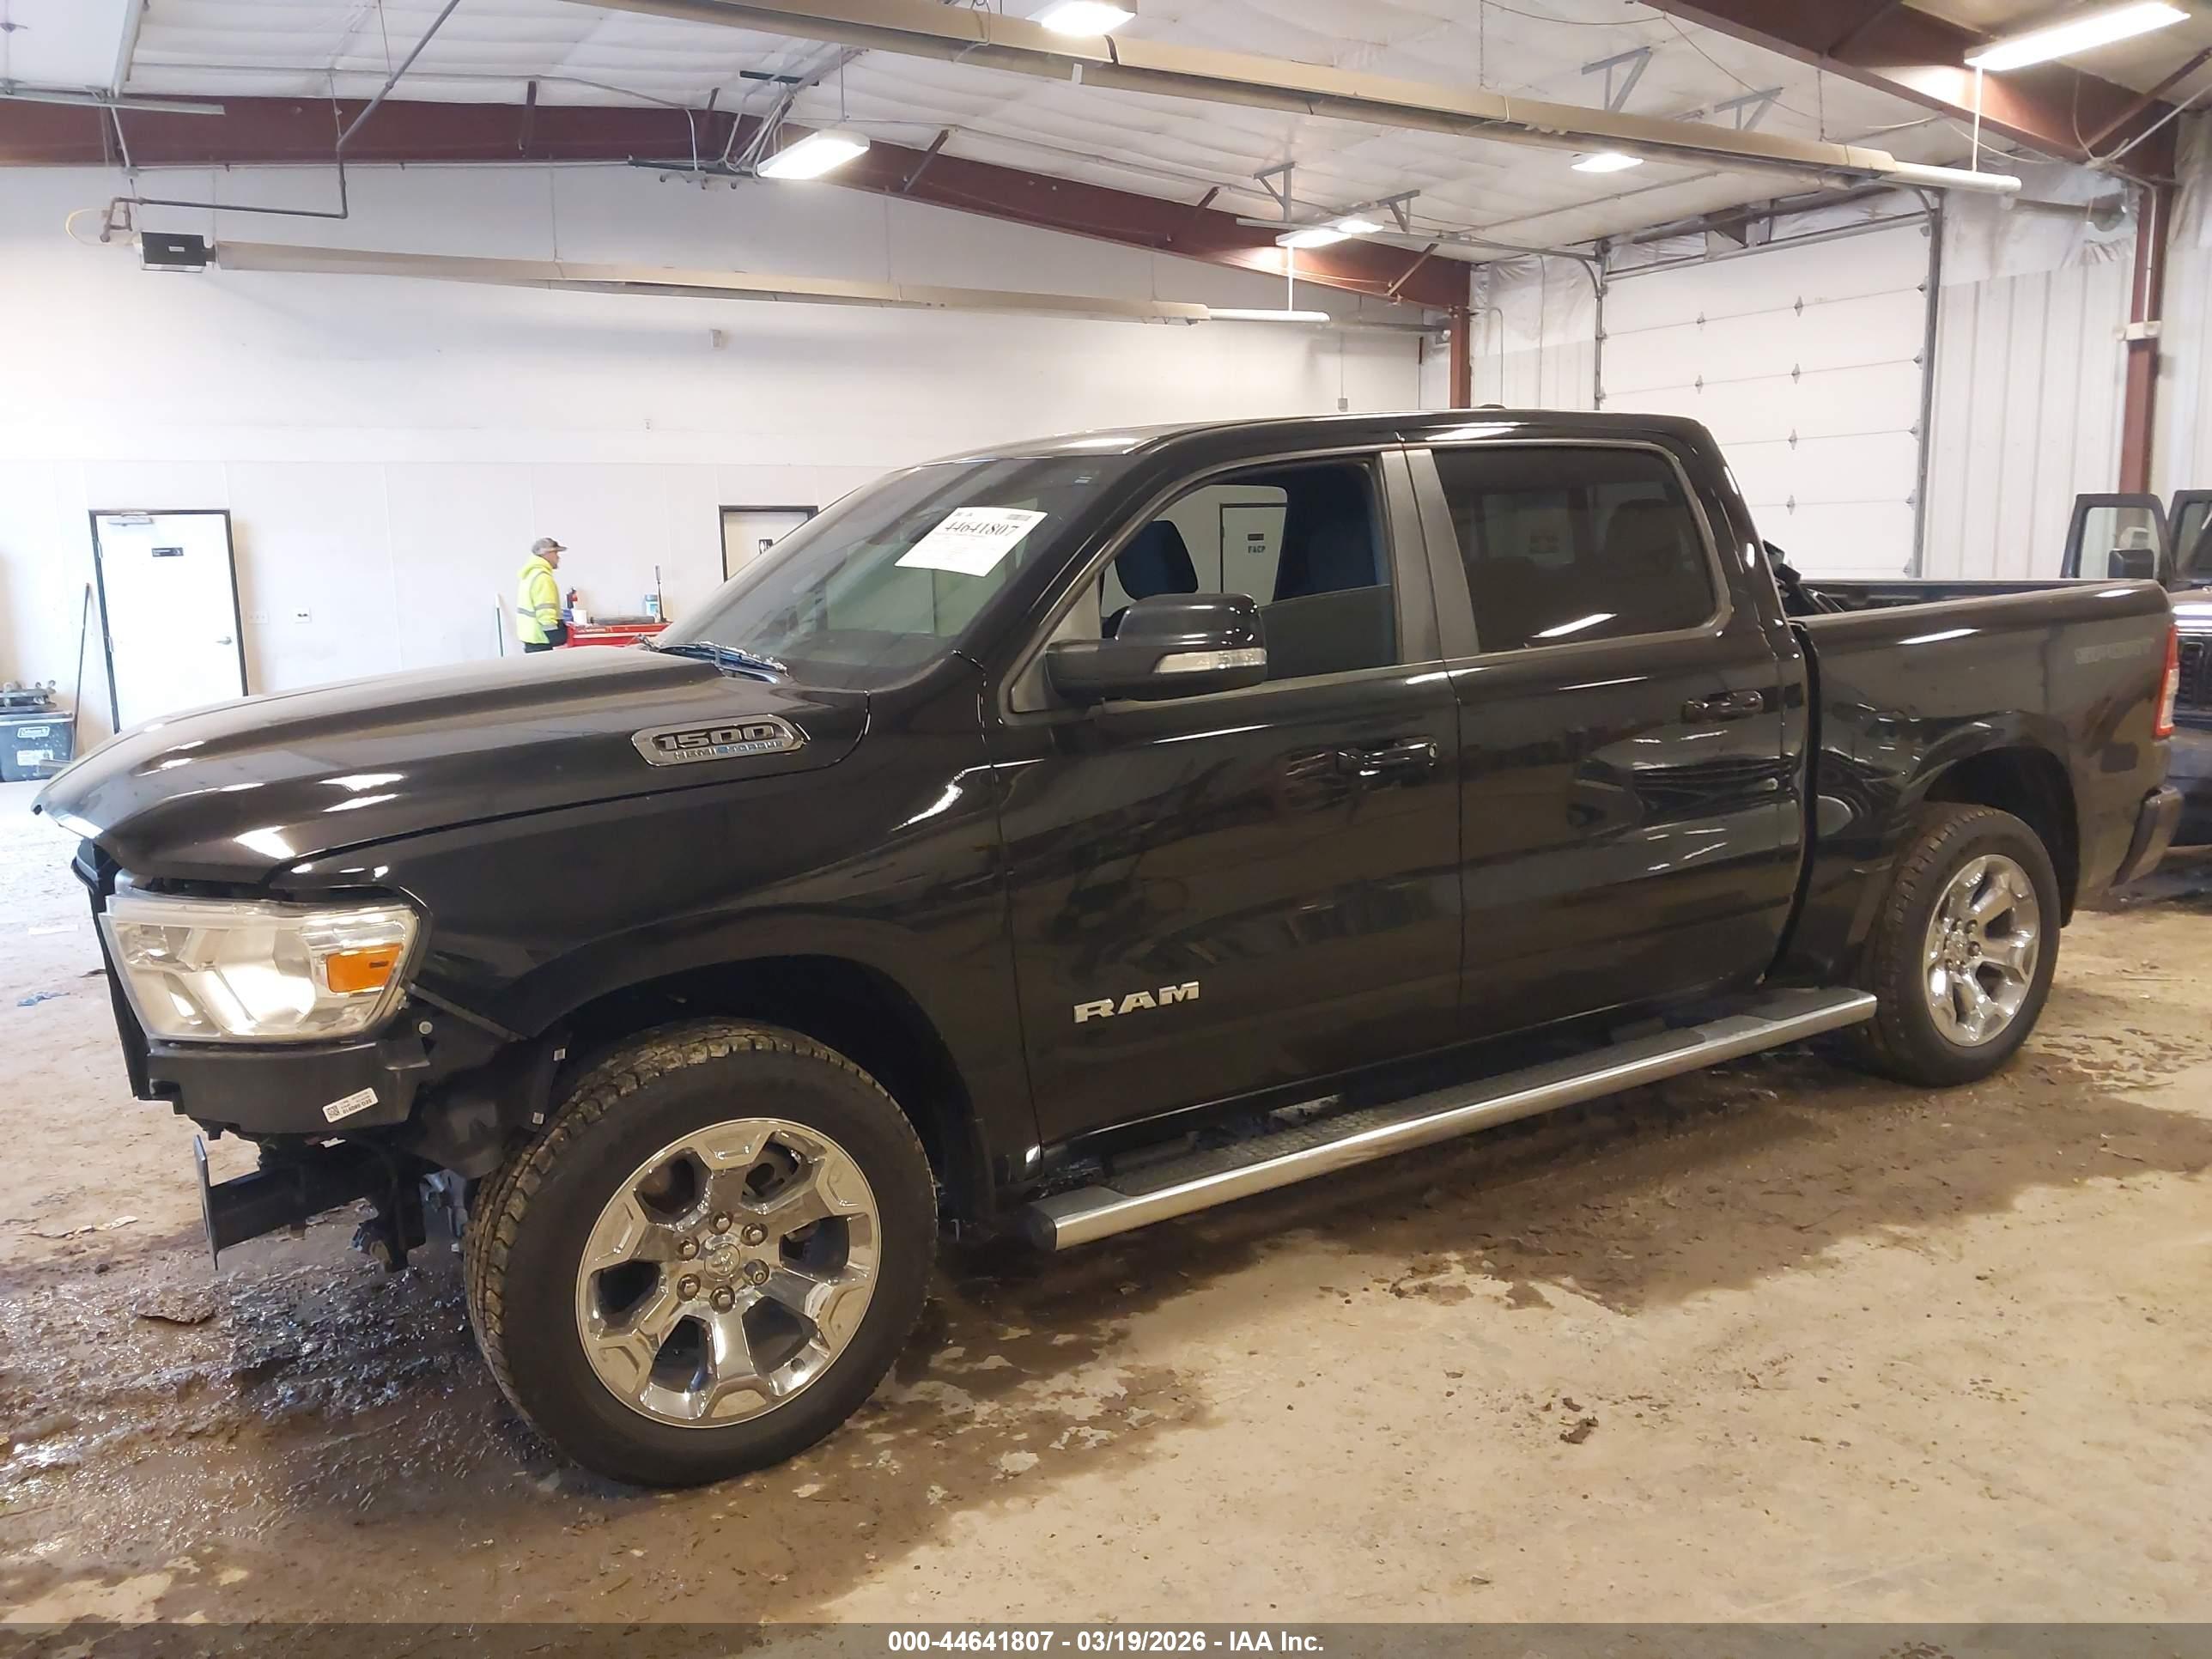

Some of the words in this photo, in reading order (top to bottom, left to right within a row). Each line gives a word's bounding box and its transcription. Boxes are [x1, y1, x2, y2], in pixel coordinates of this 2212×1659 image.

[945, 521, 1020, 537] 44641807
[2075, 638, 2155, 665] SPORT
[659, 725, 775, 750] 1500
[1073, 981, 1200, 1024] RAM
